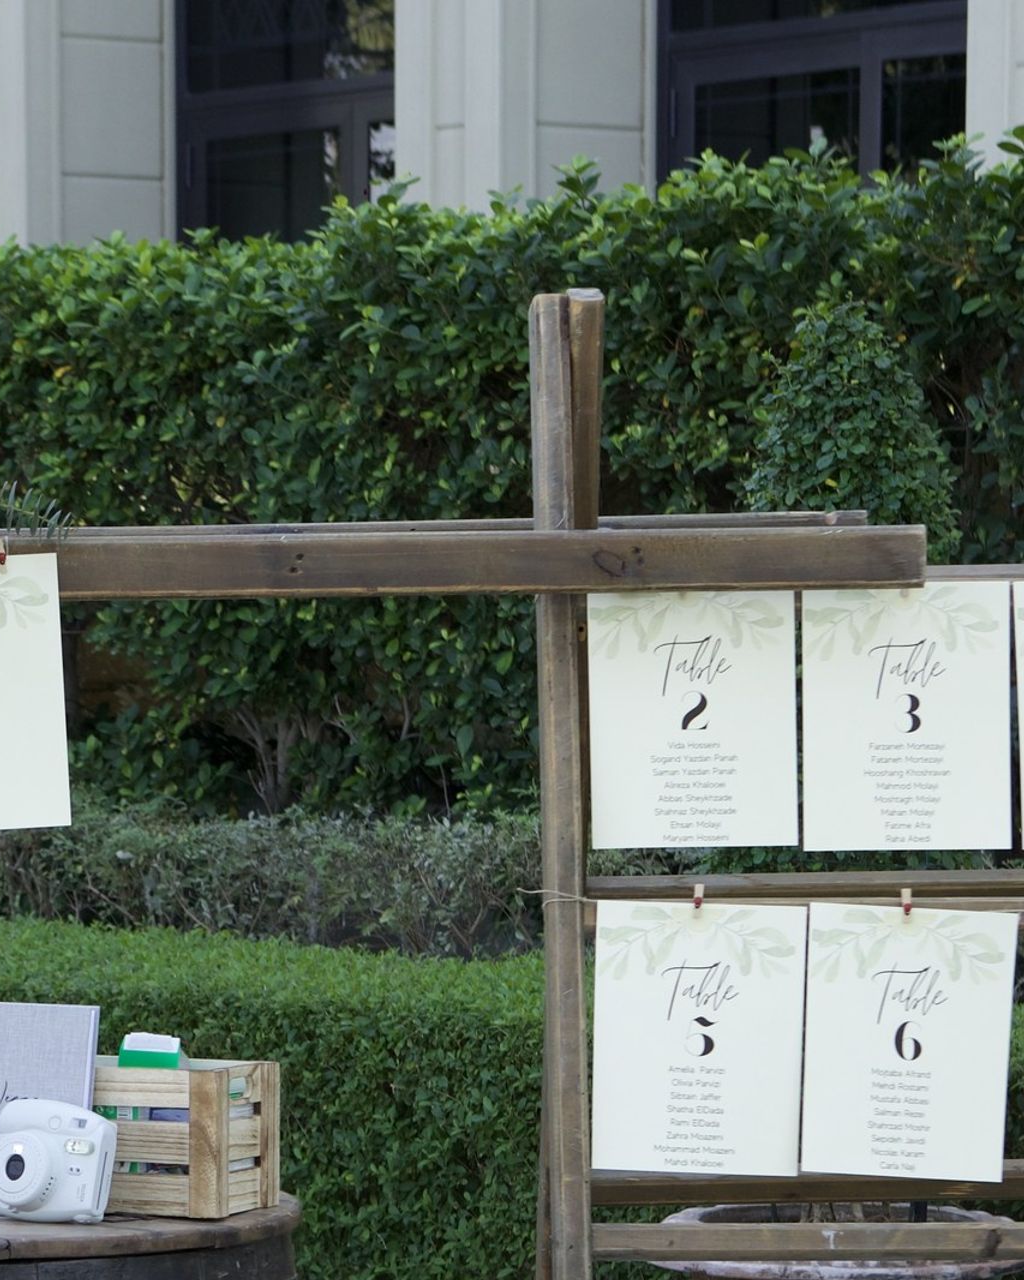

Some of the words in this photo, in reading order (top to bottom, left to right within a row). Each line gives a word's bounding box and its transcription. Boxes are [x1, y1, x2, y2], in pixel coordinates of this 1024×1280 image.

[653, 634, 732, 696] Table
[867, 637, 947, 700] Table
[680, 690, 710, 731] 2
[894, 693, 922, 734] 3
[660, 958, 739, 1021] Table
[870, 962, 948, 1024] Table
[684, 1016, 718, 1057] 5
[894, 1020, 922, 1062] 6
